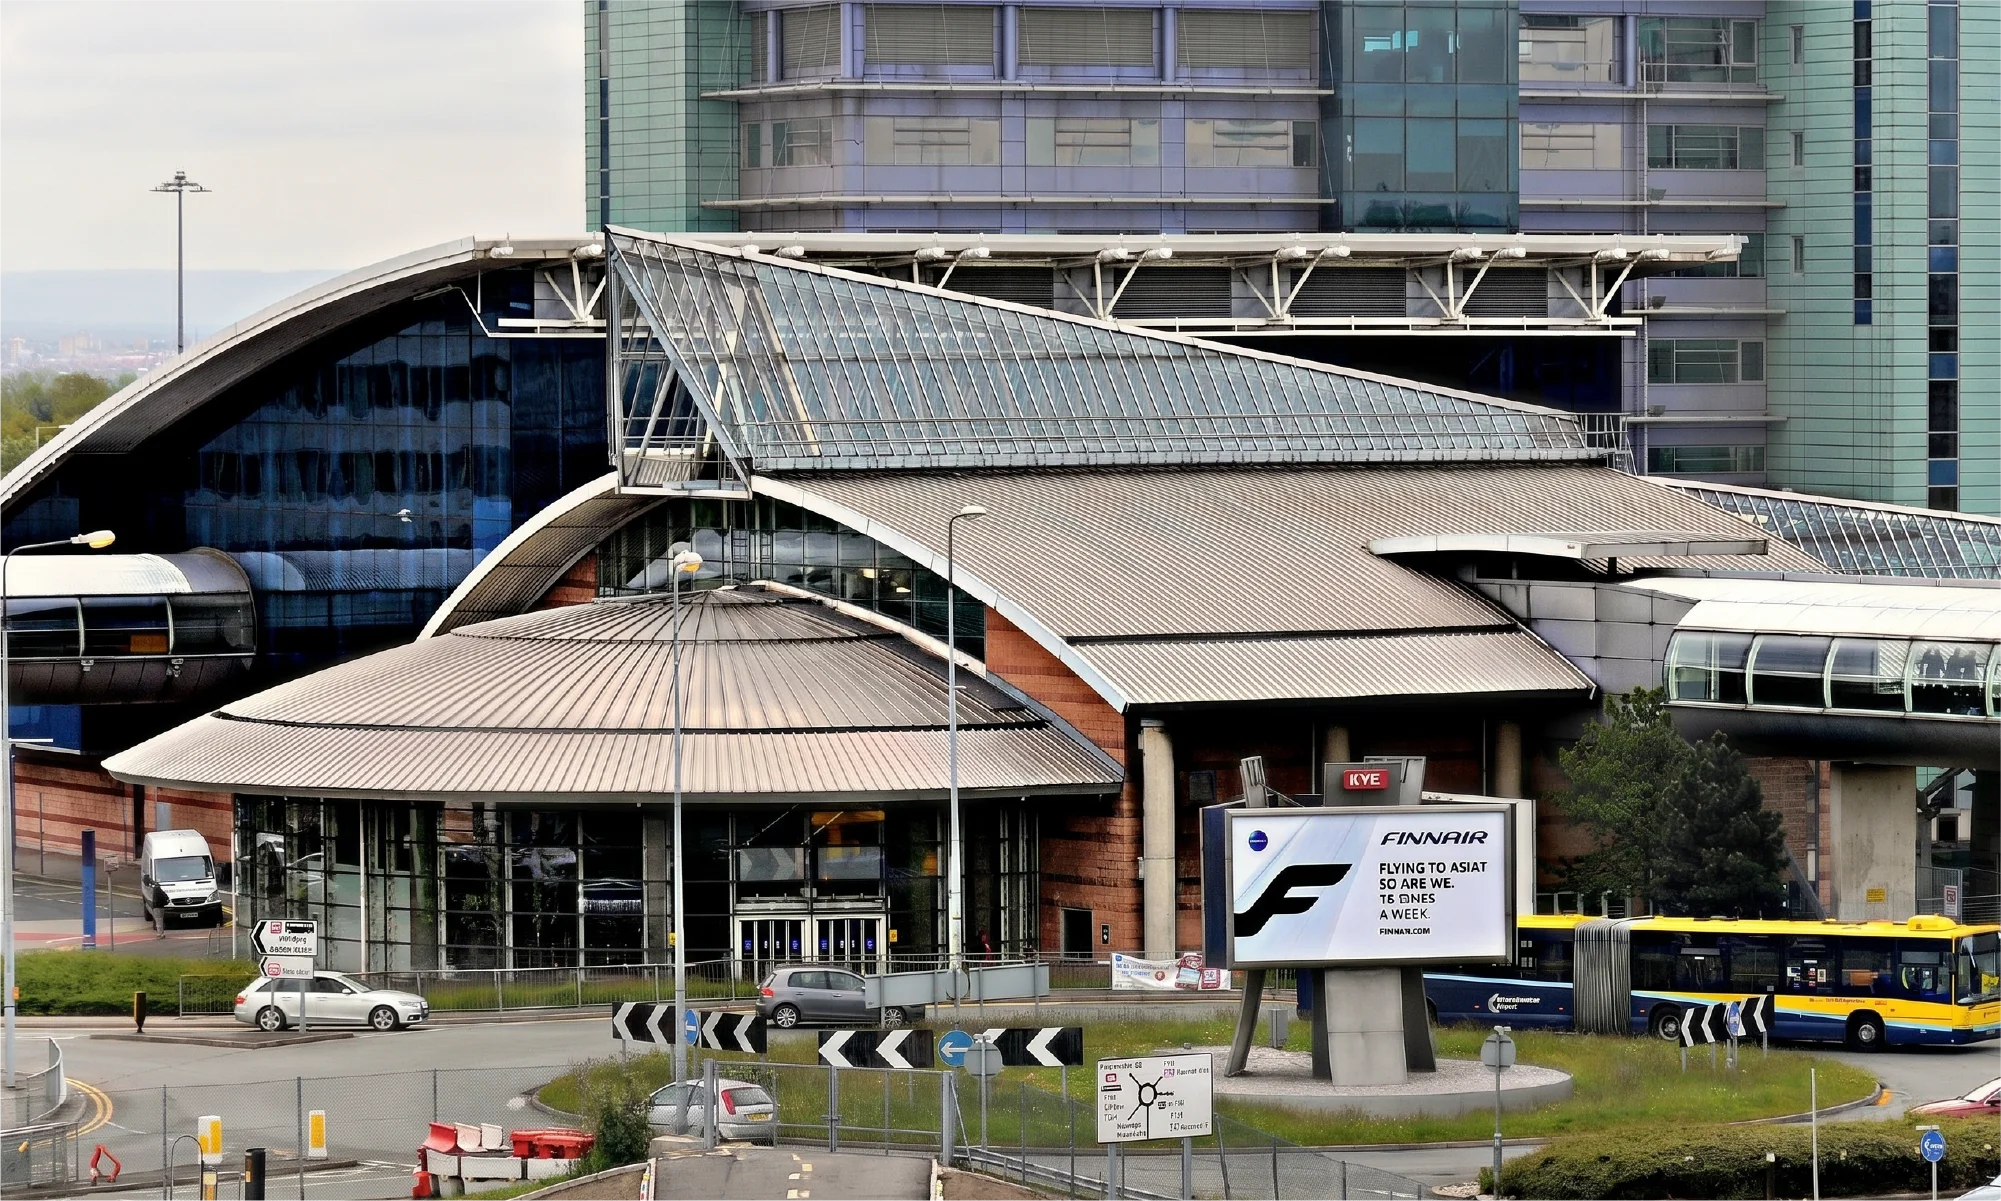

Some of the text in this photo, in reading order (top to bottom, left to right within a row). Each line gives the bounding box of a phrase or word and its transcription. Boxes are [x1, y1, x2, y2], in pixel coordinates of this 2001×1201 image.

[1380, 831, 1489, 845] FINNAIR
[1379, 863, 1425, 874] FLYING
[1428, 862, 1446, 873] TO
[1379, 877, 1455, 890] SO ARE WE.
[1379, 908, 1431, 920] A WEEK.
